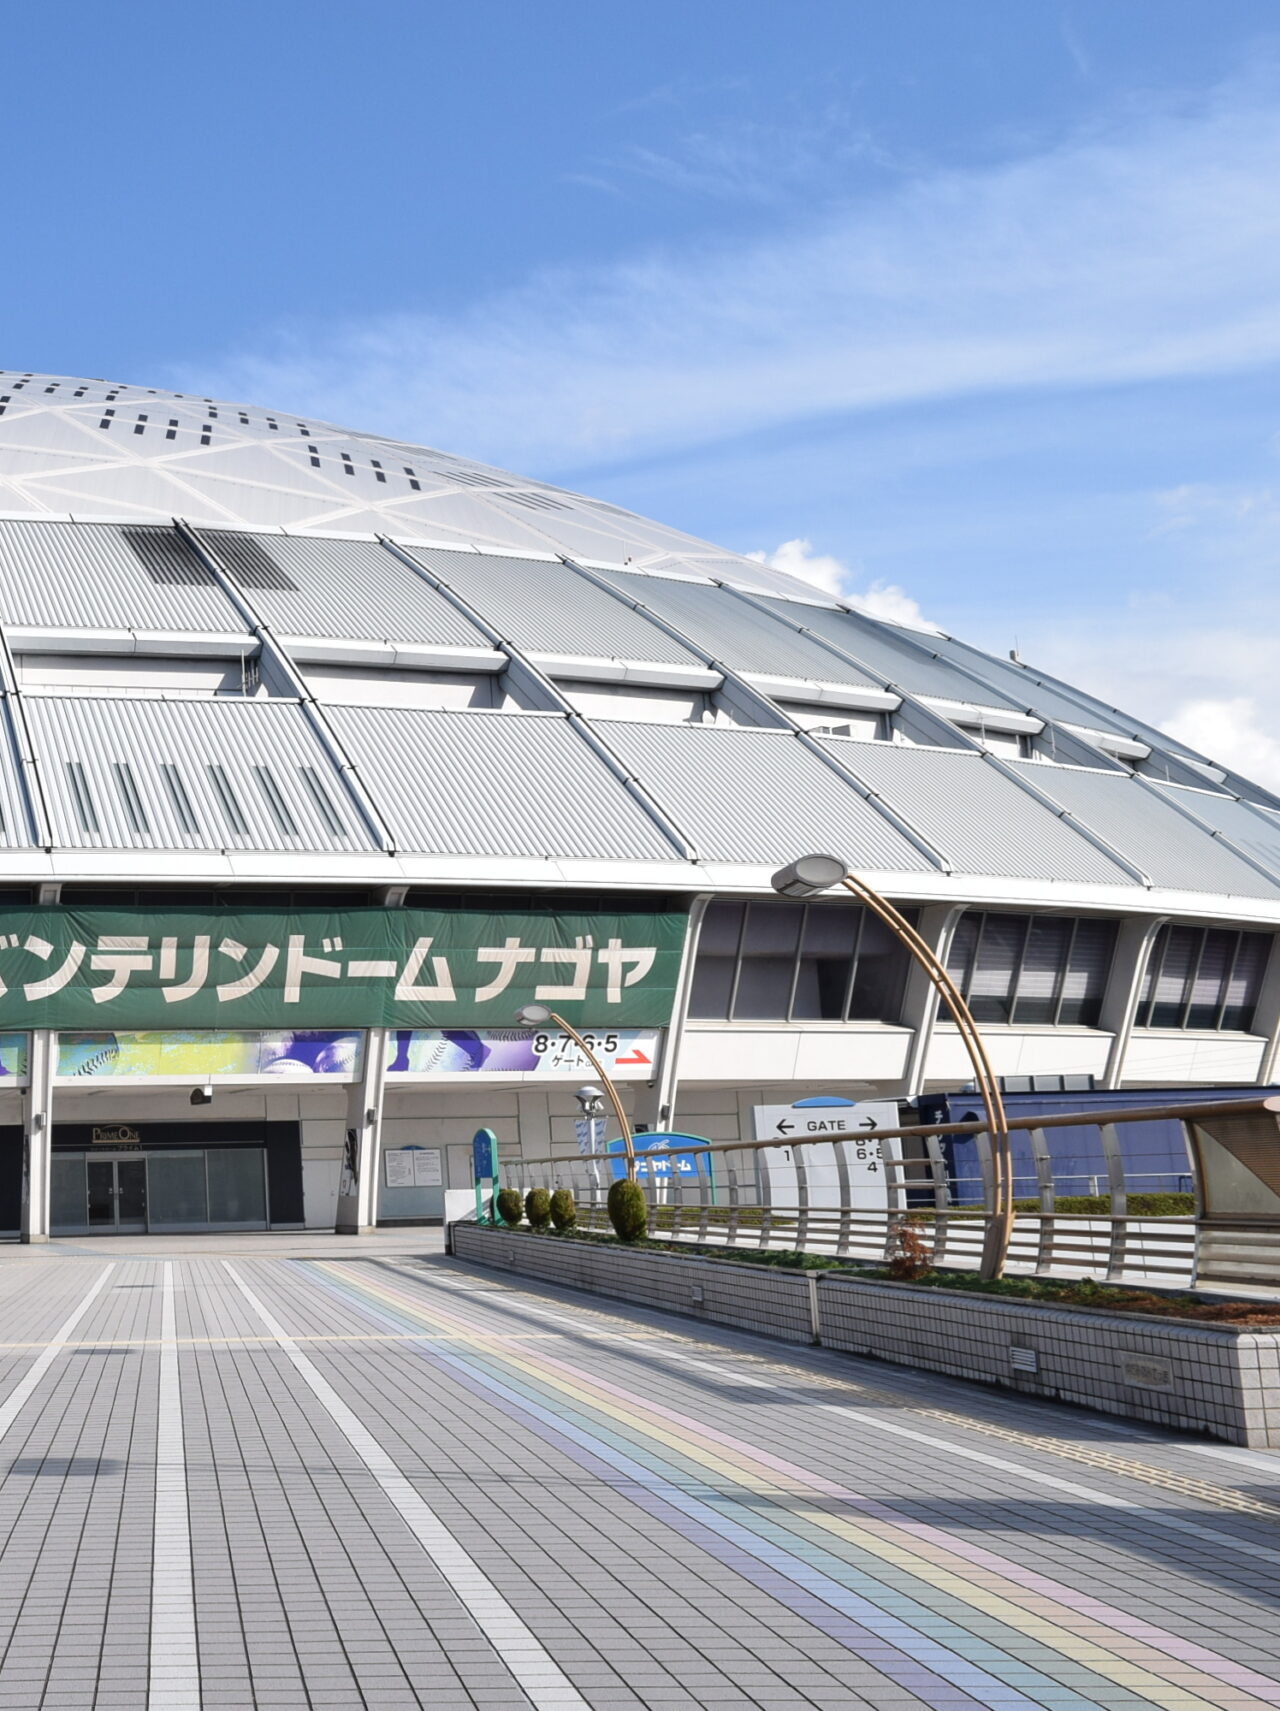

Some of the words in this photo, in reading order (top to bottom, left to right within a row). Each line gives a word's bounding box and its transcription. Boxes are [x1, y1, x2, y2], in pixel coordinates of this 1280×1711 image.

[475, 935, 657, 1003] ナゴヤ
[552, 1055, 584, 1067] ゲート
[807, 1120, 846, 1131] GATE
[867, 1162, 878, 1172] 4
